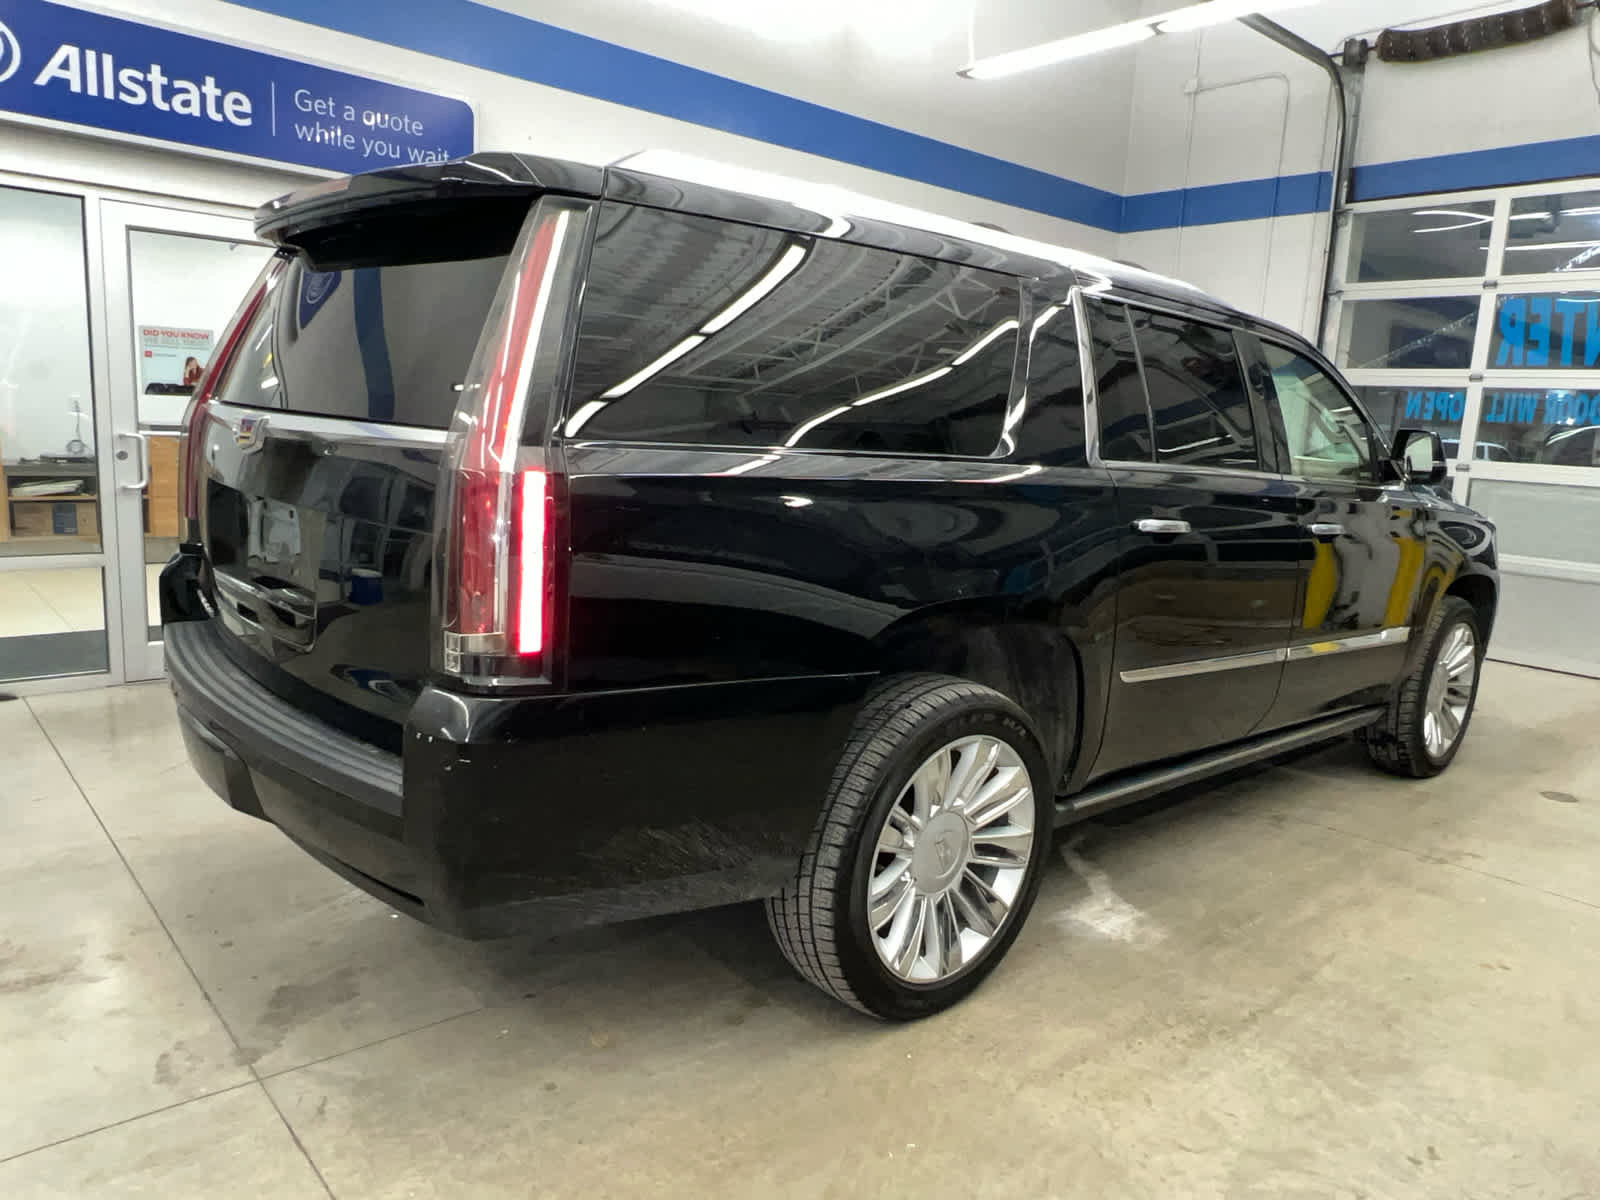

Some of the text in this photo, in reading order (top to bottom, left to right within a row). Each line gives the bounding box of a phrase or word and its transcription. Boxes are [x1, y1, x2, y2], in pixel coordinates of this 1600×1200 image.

[34, 44, 253, 127] Allstate
[295, 89, 424, 136] Get a quote
[295, 121, 450, 164] while you wait
[161, 330, 178, 338] YOU
[179, 331, 208, 339] KNOW
